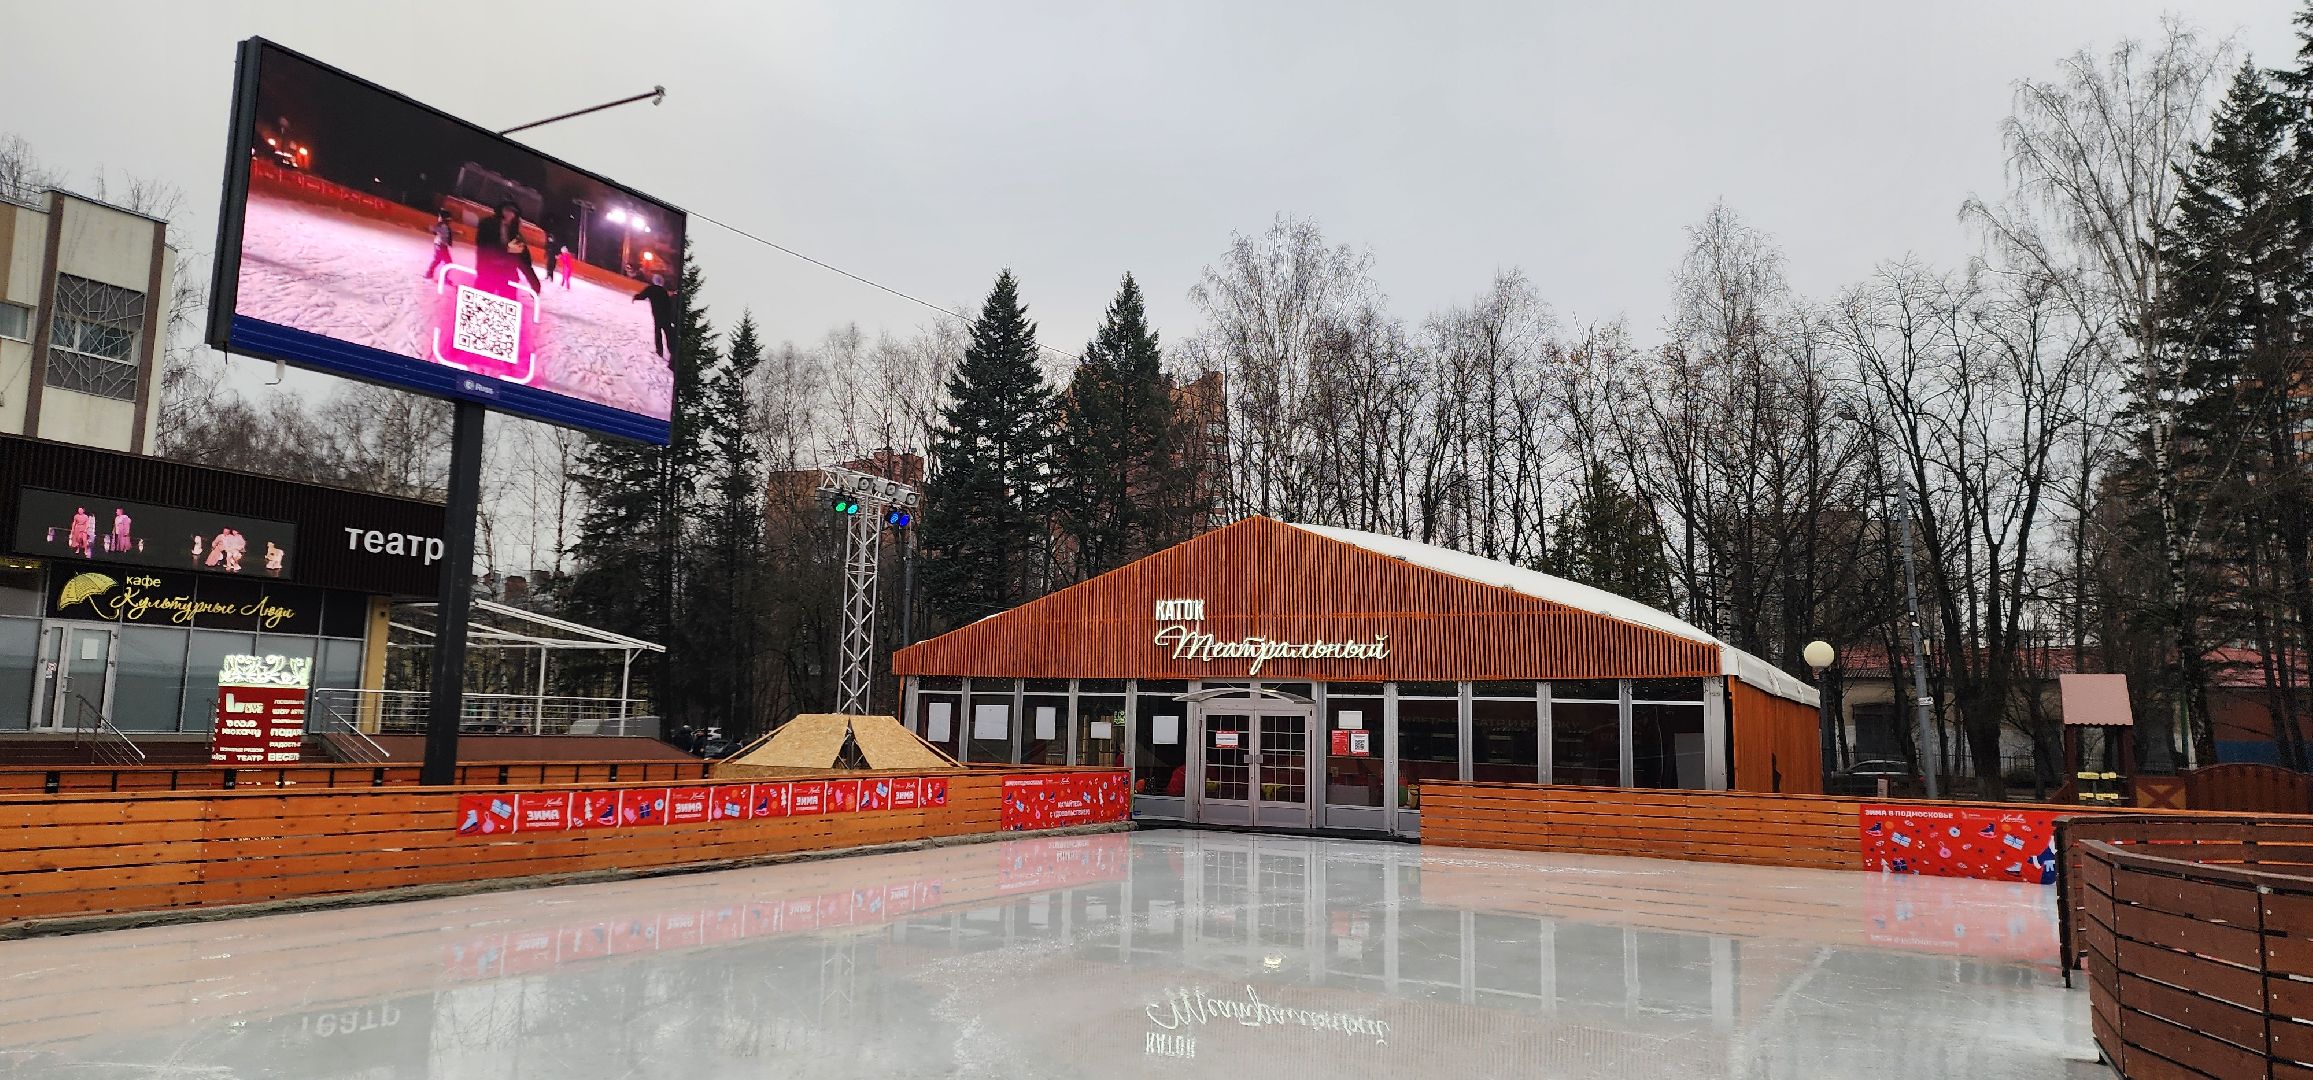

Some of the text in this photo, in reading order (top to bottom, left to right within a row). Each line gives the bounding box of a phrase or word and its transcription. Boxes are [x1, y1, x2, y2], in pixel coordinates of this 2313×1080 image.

[344, 526, 444, 566] театр
[126, 574, 162, 588] кафе
[110, 586, 295, 629] Культурные Люди
[1155, 599, 1205, 621] КАТОК
[1154, 625, 1391, 676] Театральный
[526, 809, 560, 821] ЗИМА
[1895, 810, 1954, 819] ПОДМОСКОВЬЕ
